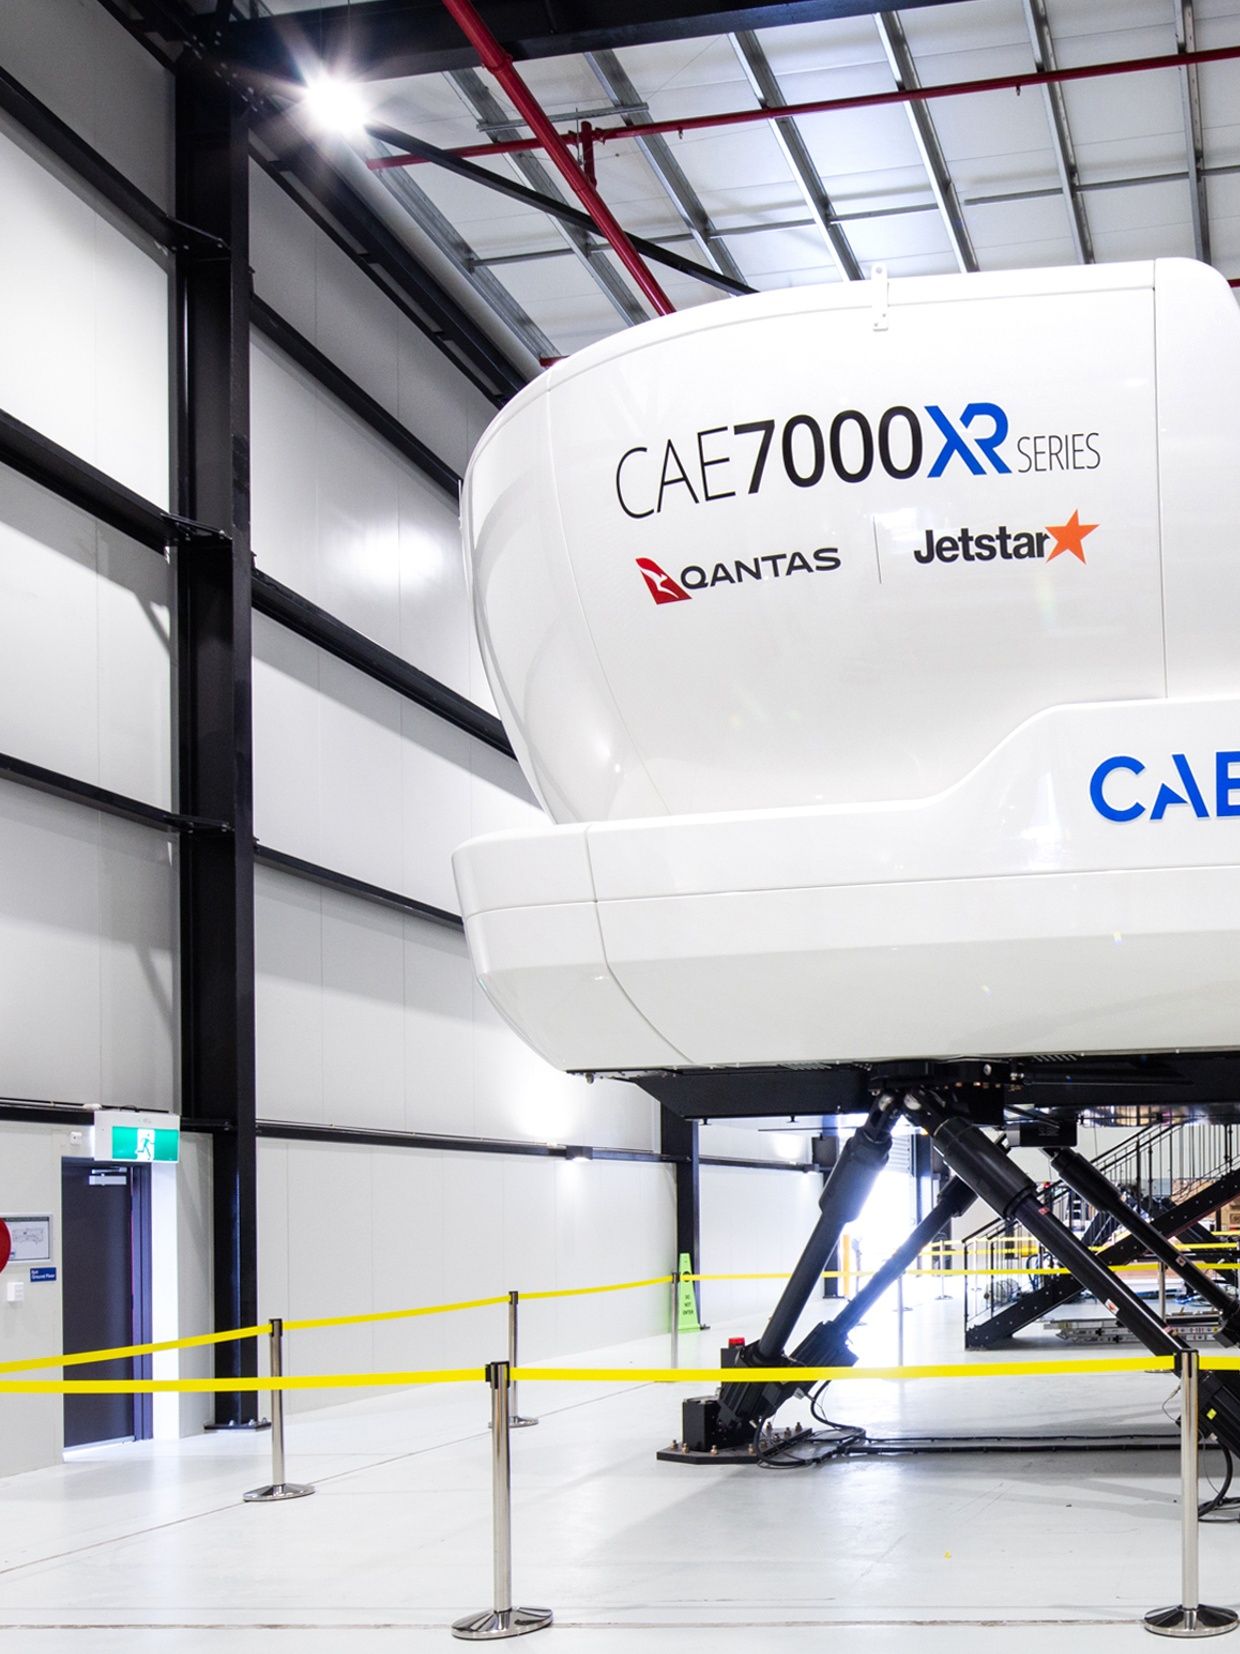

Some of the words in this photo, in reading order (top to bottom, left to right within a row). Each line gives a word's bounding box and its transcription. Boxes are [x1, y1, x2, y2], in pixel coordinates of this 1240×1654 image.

[616, 402, 1012, 519] CAE7000XR
[1017, 432, 1101, 473] SERIES
[914, 525, 1049, 564] Jetstar
[680, 546, 841, 590] QANTAS
